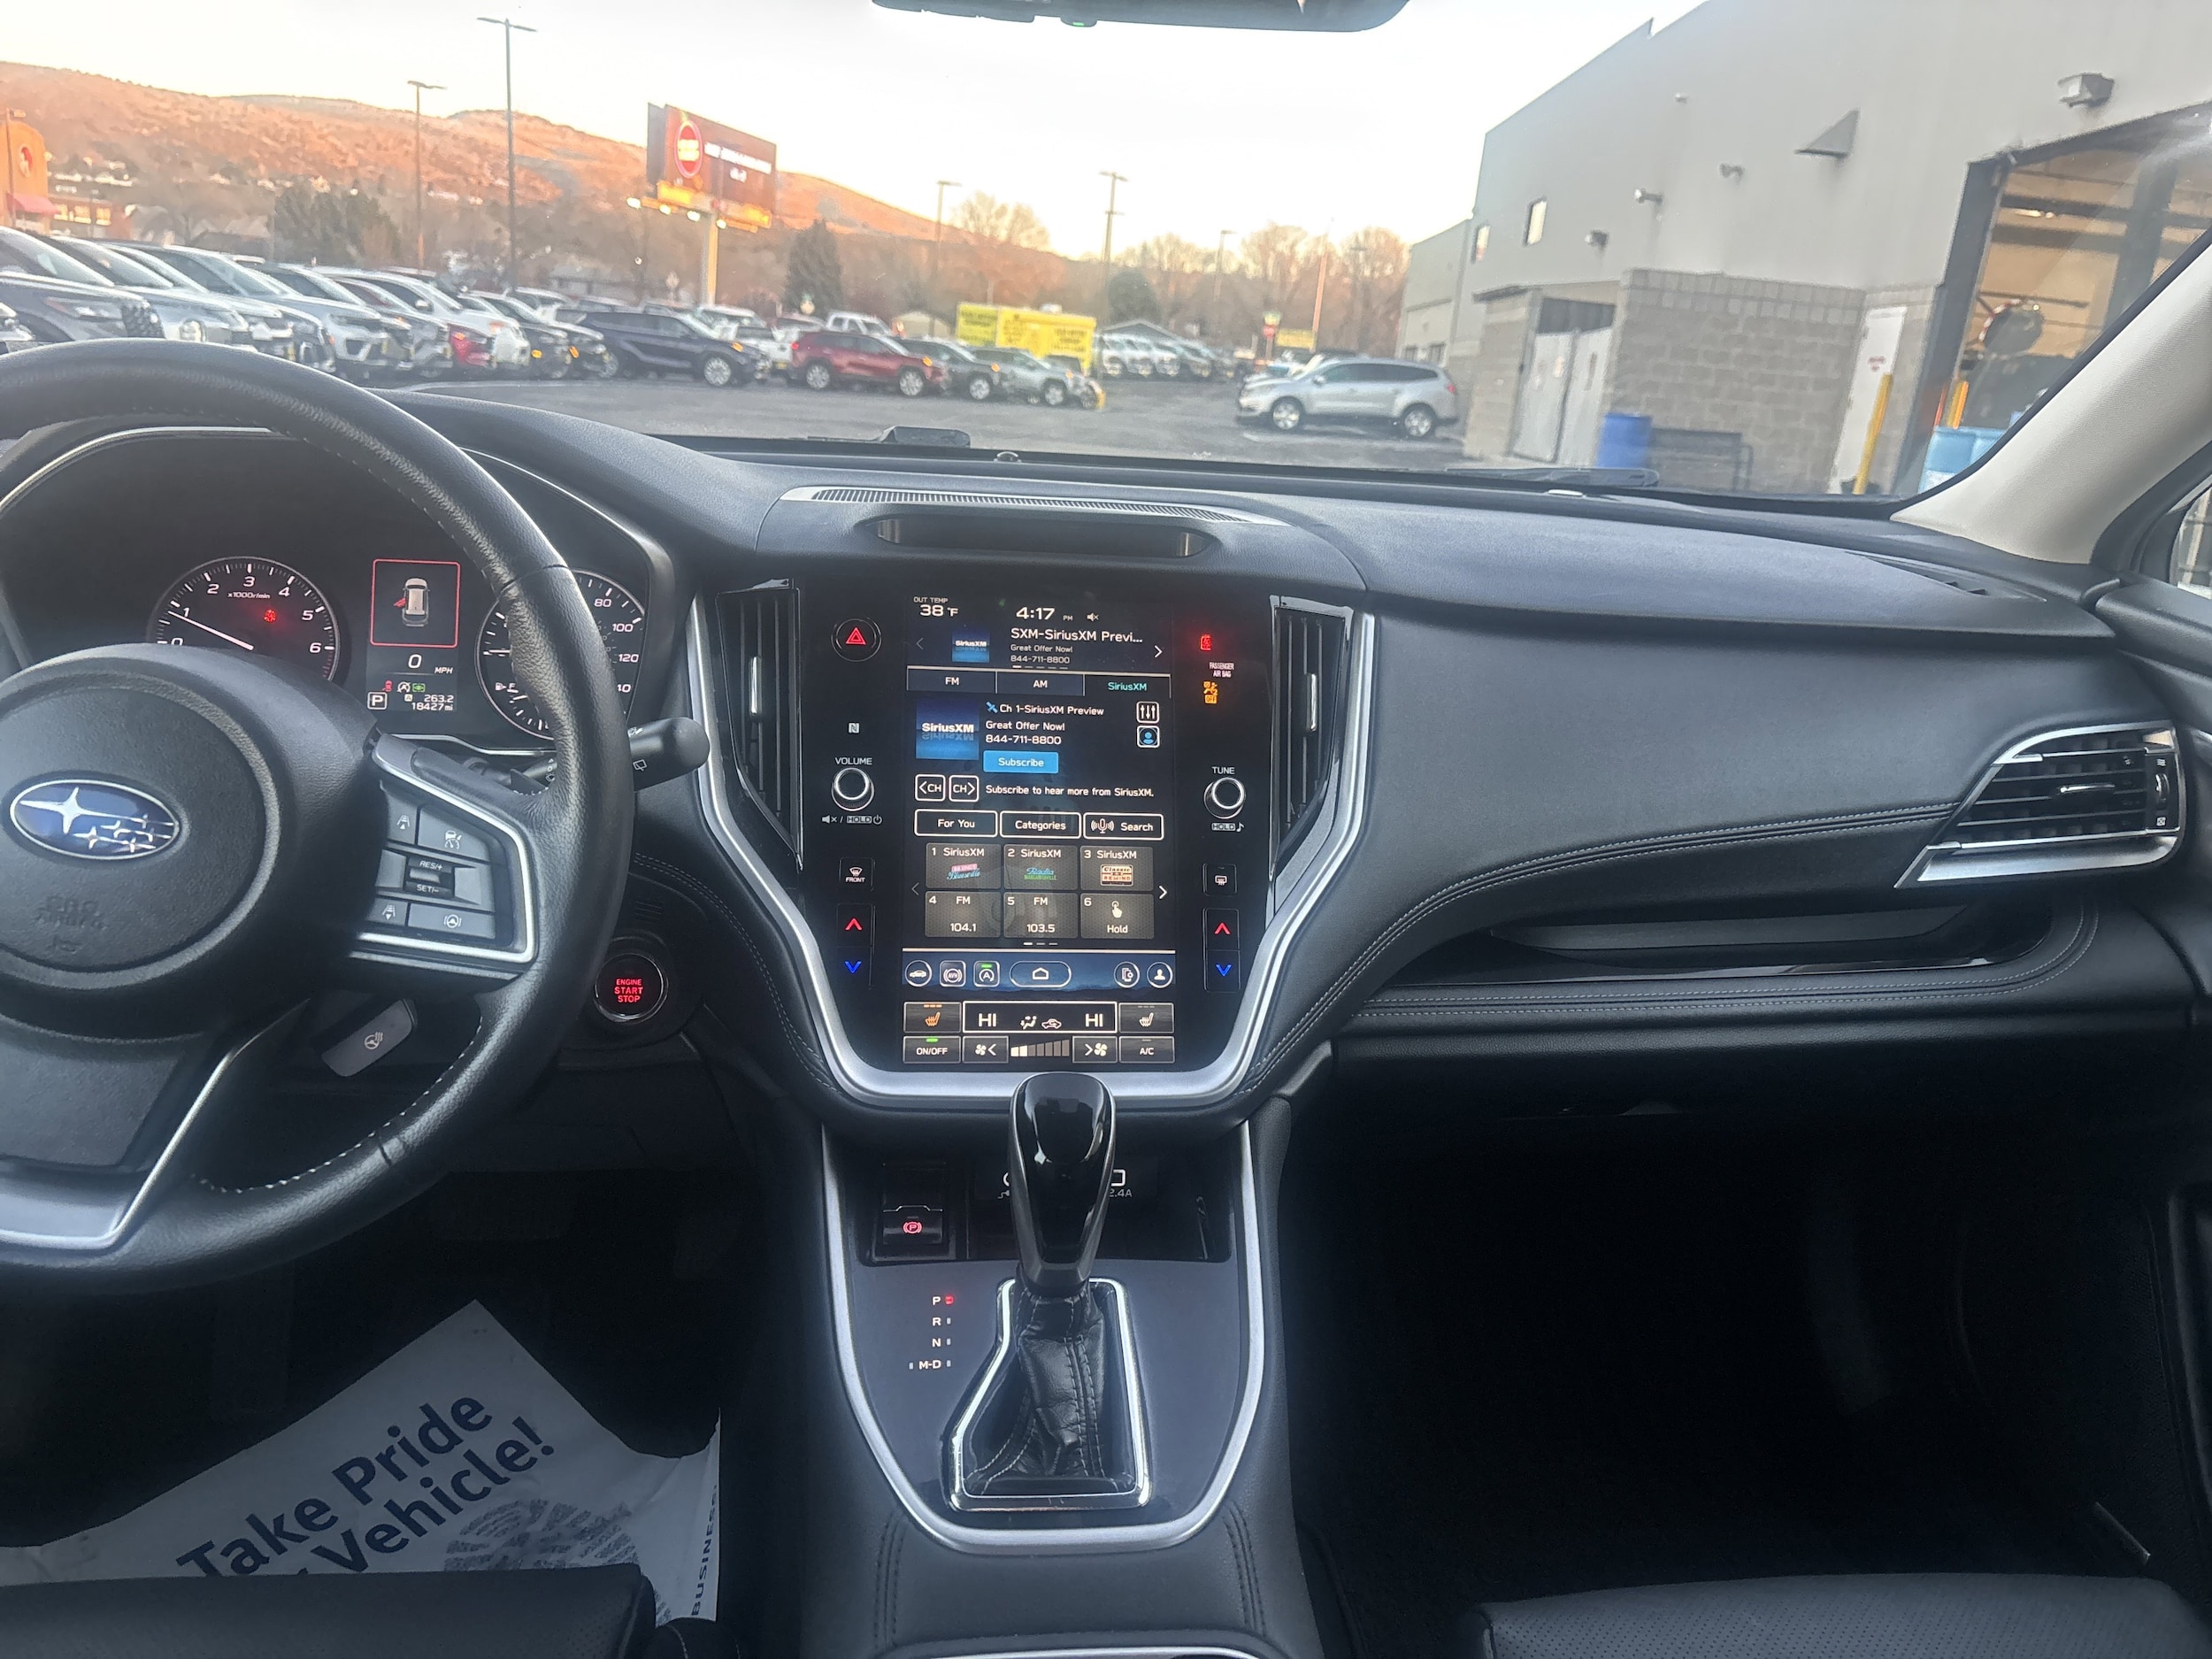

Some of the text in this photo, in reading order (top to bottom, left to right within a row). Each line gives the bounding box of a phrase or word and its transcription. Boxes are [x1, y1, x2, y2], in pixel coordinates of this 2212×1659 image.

[243, 576, 256, 587] 3
[207, 584, 220, 595] 2
[279, 587, 290, 597] 4
[227, 591, 271, 600] x1000r/min
[594, 598, 612, 608] 80
[182, 607, 191, 618] 1
[919, 603, 944, 617] 38
[1016, 606, 1056, 620] 4:17
[302, 610, 313, 621] 5
[612, 623, 634, 633] 100
[1010, 626, 1097, 641] SXM-SiriusXM
[310, 642, 321, 653] 6
[408, 654, 422, 669] 0
[618, 653, 640, 663] 120
[1010, 655, 1071, 664] 844-711-8800
[1209, 662, 1235, 671] PASSENGER
[945, 677, 960, 686] FM
[1033, 680, 1048, 688] AM
[1107, 681, 1148, 691] SiriusXM
[372, 695, 384, 707] P
[424, 694, 455, 703] 263.2
[999, 703, 1104, 716] Ch 1-SiriusXM Preview
[921, 722, 975, 733] SiriusXM
[985, 720, 1065, 731] Great Offer Now!
[985, 733, 1062, 745] 844-711-8800
[834, 757, 873, 765] VOLUME
[998, 757, 1045, 767] Subscribe
[1211, 766, 1235, 775] TUNE
[985, 784, 1030, 795] Subscribe
[1032, 786, 1042, 795] to
[1044, 787, 1064, 795] hear
[1091, 787, 1111, 796] from
[1114, 787, 1155, 797] SiriusXM.
[847, 815, 872, 824] HOLD
[937, 818, 975, 828] For You
[1015, 820, 1067, 832] Categories
[1120, 822, 1154, 832] Search
[1211, 822, 1236, 832] HOLD
[931, 847, 985, 856] 1 SiriusXM
[1007, 849, 1062, 858] 2 SiriusXM
[1084, 849, 1137, 859] 3 SiriusXM
[928, 895, 971, 905] 4 FM
[1007, 896, 1048, 906] 5 FM
[1084, 897, 1092, 907] 6
[950, 922, 977, 933] 104.1
[1026, 923, 1056, 933] 103.5
[1107, 925, 1128, 933] Hold
[614, 986, 644, 995] START
[618, 995, 641, 1003] STOP
[978, 1012, 997, 1027] HI
[1085, 1013, 1103, 1027] HI
[916, 1047, 949, 1056] ON/OFF
[1139, 1047, 1155, 1056] A/C
[932, 1296, 941, 1305] P
[932, 1317, 941, 1326] R
[932, 1338, 941, 1348] N
[175, 1397, 493, 1576] Take Pride
[311, 1416, 555, 1573] Vehicle!
